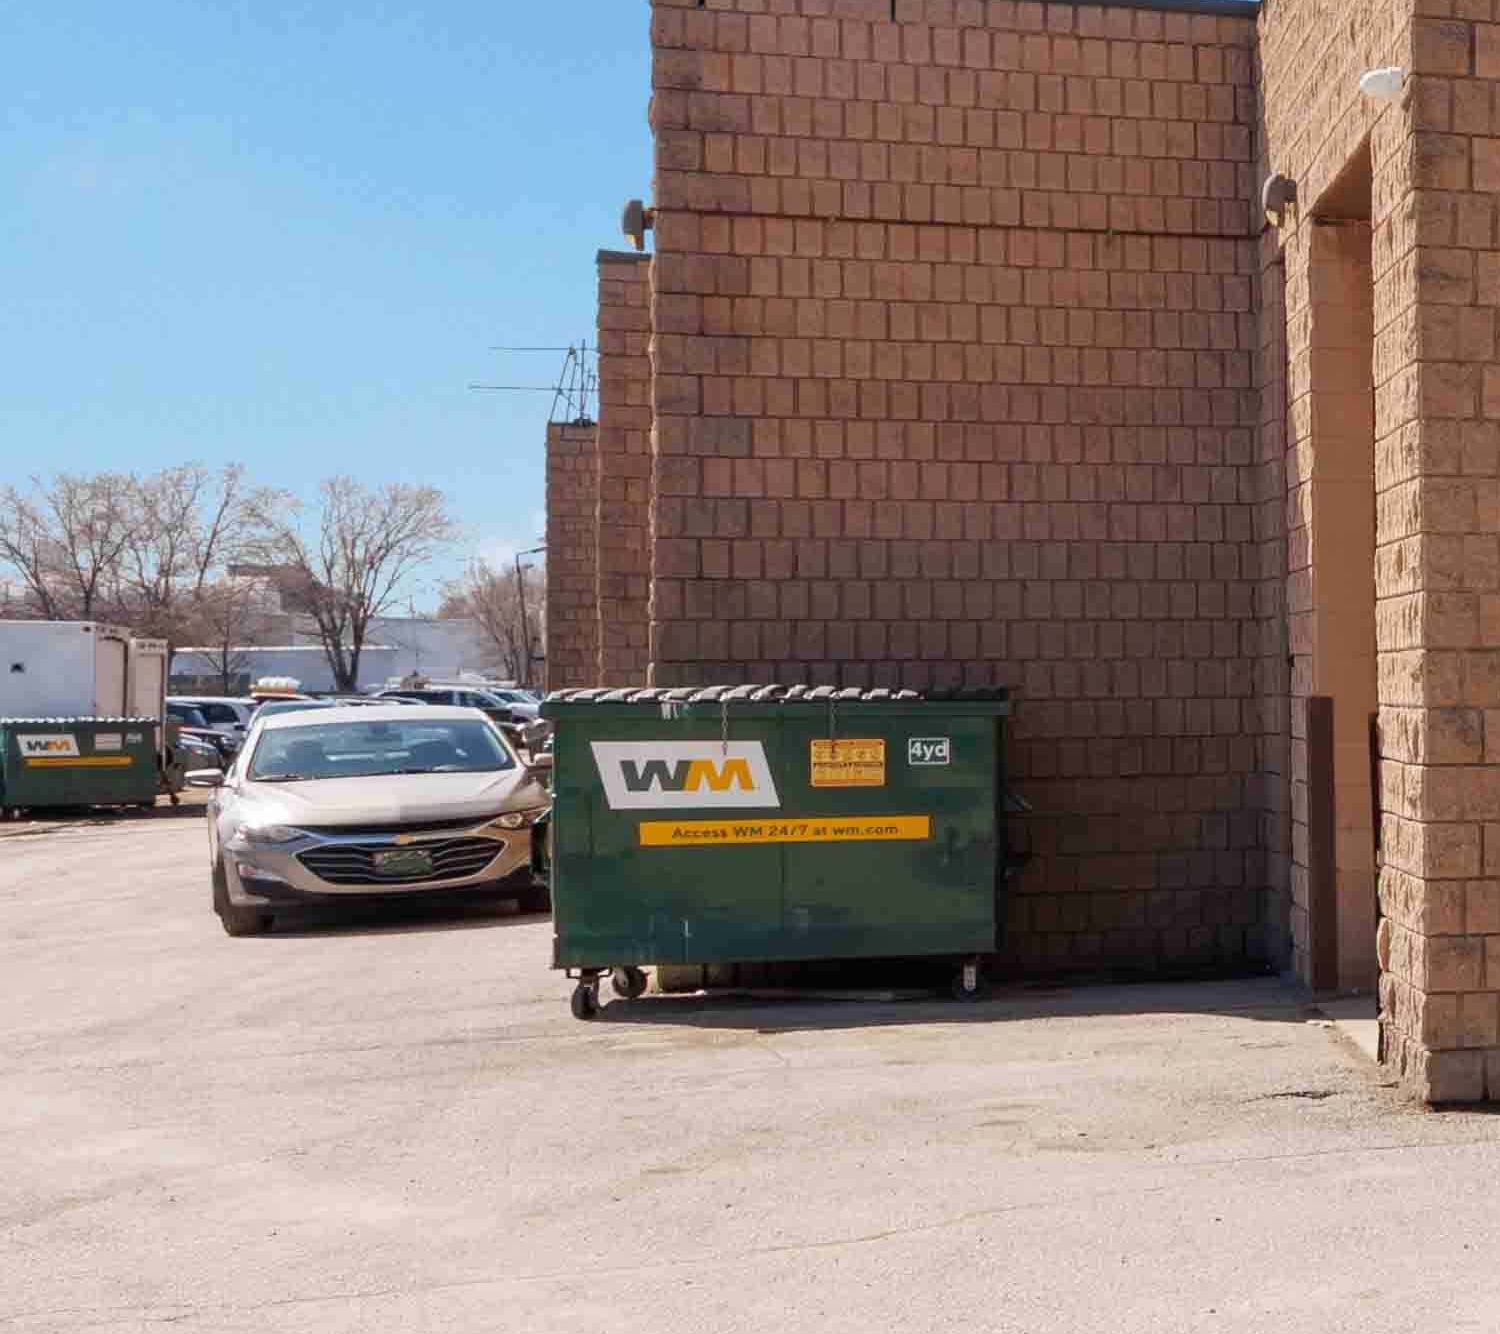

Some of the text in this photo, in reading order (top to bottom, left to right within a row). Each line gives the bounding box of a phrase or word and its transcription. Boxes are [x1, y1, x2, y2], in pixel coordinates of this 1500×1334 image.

[910, 741, 947, 761] 4yd
[619, 758, 754, 792] WM
[671, 823, 899, 840] Access WM 24/7 at wm.com
